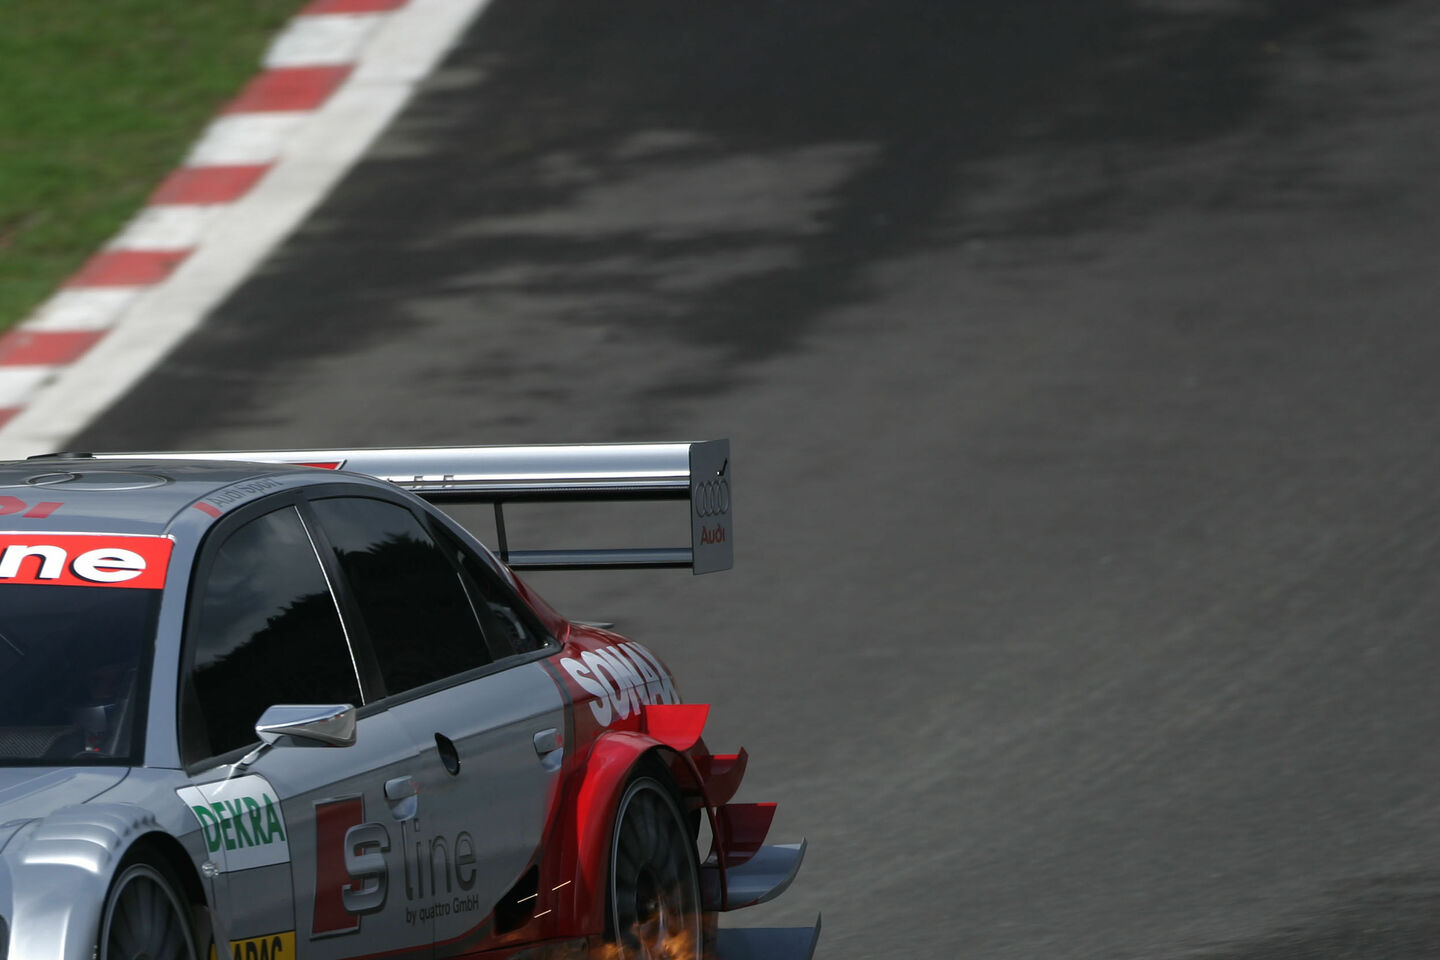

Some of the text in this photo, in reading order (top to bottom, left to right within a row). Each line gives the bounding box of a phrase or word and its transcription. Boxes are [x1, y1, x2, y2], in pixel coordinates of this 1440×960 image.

[700, 524, 726, 545] Audi
[192, 793, 286, 853] DEKRA
[401, 817, 478, 900] line
[419, 901, 452, 920] quattro
[453, 896, 479, 913] GmbH
